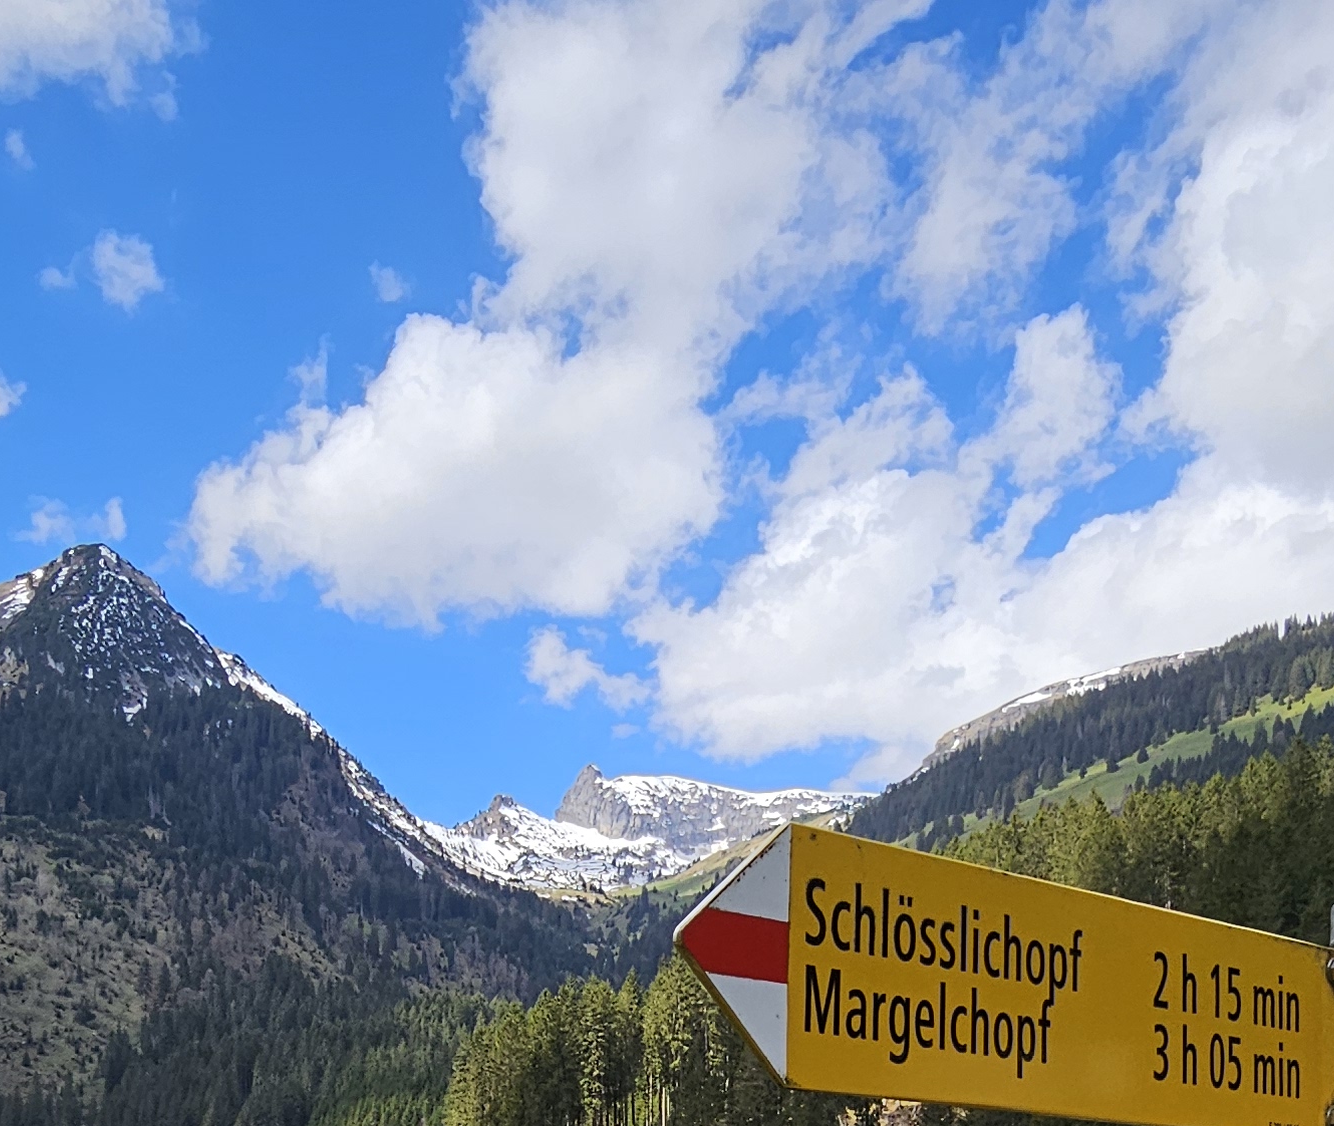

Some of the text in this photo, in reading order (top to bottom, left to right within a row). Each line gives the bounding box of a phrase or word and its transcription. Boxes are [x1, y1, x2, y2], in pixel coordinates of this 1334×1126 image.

[804, 877, 1300, 1033] Schlösslichopf 2 h 15 min
[803, 963, 1300, 1099] Margelchopf 3 h 05 min
